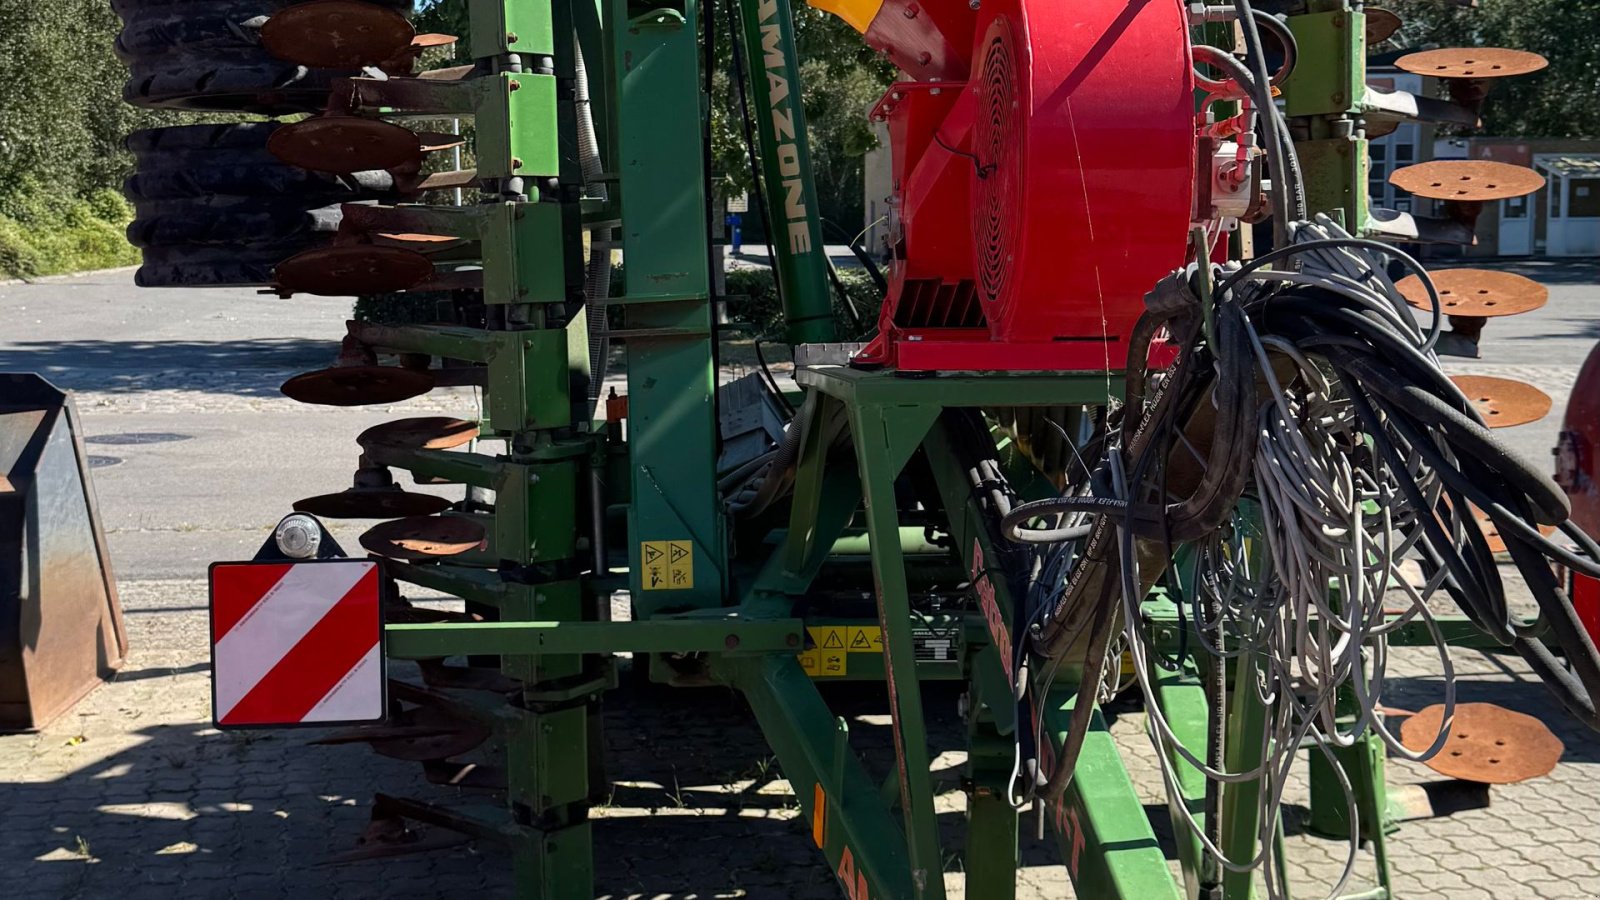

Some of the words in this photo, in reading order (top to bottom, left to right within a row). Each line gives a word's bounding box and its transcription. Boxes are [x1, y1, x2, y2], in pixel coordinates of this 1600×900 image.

[758, 0, 811, 254] AMAZONE
[1295, 182, 1304, 200] BAR
[1161, 377, 1170, 389] EN
